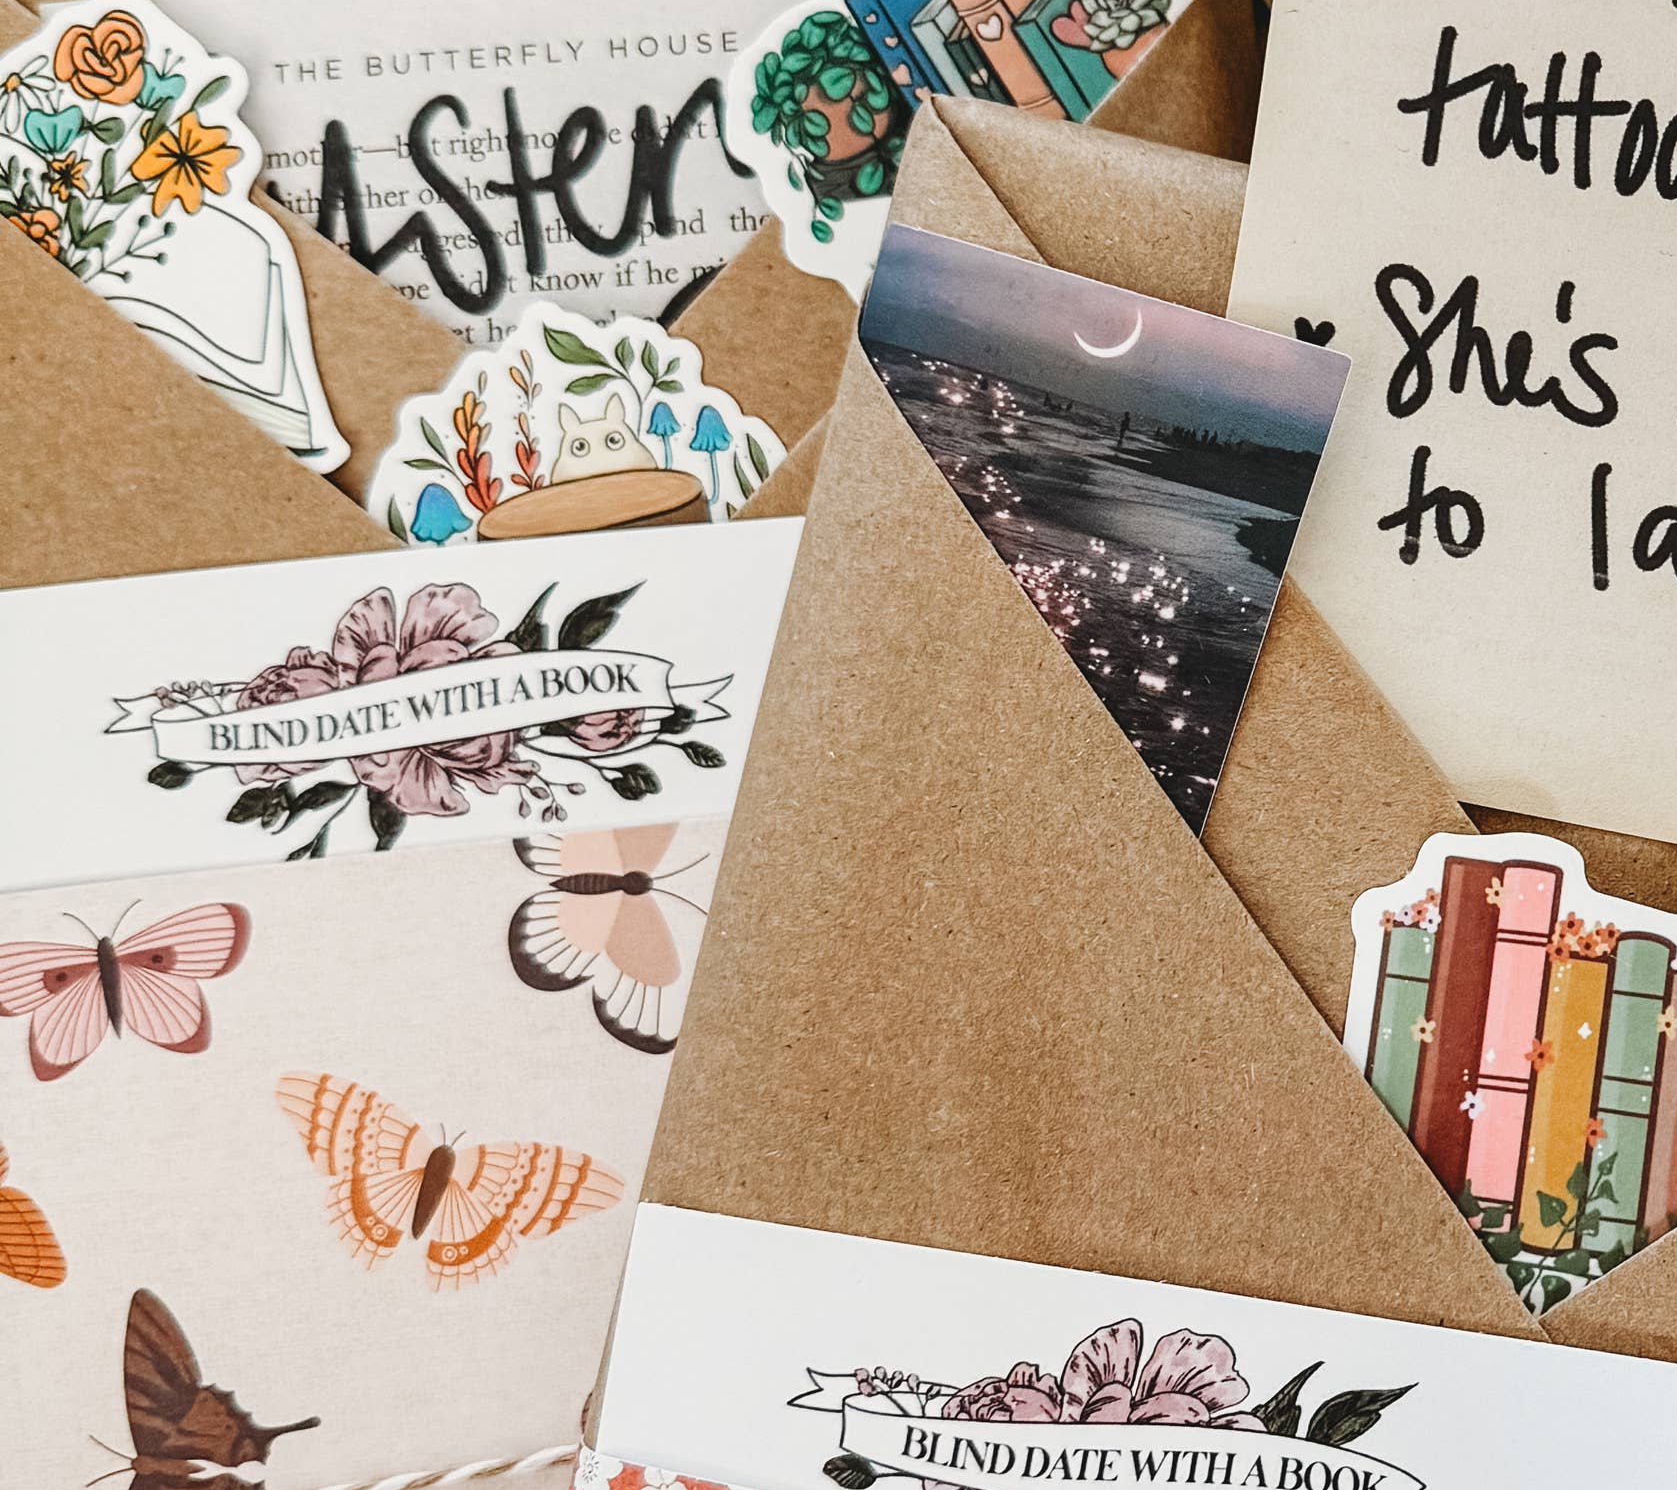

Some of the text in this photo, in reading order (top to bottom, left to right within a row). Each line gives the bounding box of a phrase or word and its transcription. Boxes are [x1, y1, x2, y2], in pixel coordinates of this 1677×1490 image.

[274, 30, 740, 84] THE BUTTERFLY HOUSE
[448, 127, 519, 162] righ
[529, 266, 604, 293] know
[614, 260, 640, 287] if
[646, 259, 680, 286] he
[1374, 263, 1619, 428] She's
[1377, 445, 1485, 566] to
[209, 662, 642, 752] BLIND DATE WITH A BOOK
[901, 1424, 1015, 1476] BLIND
[1021, 1445, 1122, 1482] DATE
[1131, 1449, 1236, 1486] WITH
[1240, 1455, 1268, 1488] A
